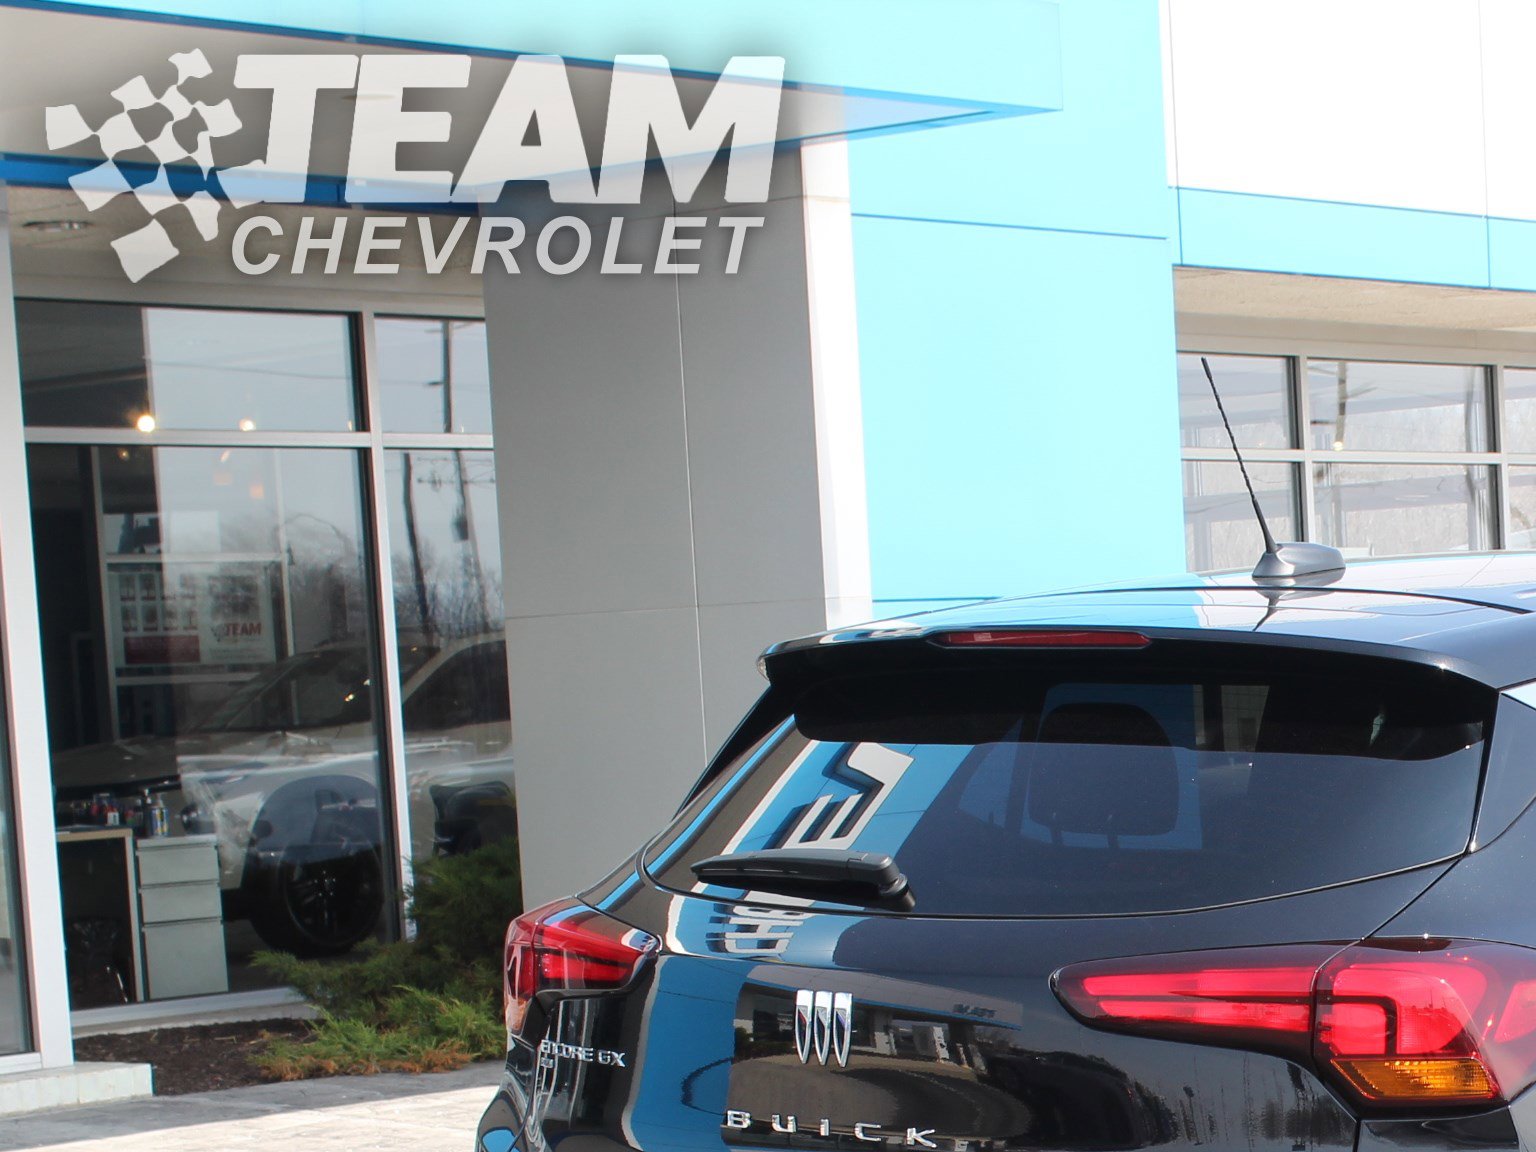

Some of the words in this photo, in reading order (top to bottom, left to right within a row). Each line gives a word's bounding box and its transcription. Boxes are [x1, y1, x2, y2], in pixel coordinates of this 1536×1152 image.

[225, 622, 262, 637] TEAM
[541, 1039, 594, 1062] ENCORE
[598, 1050, 626, 1067] GX
[726, 1110, 937, 1149] BUICK
